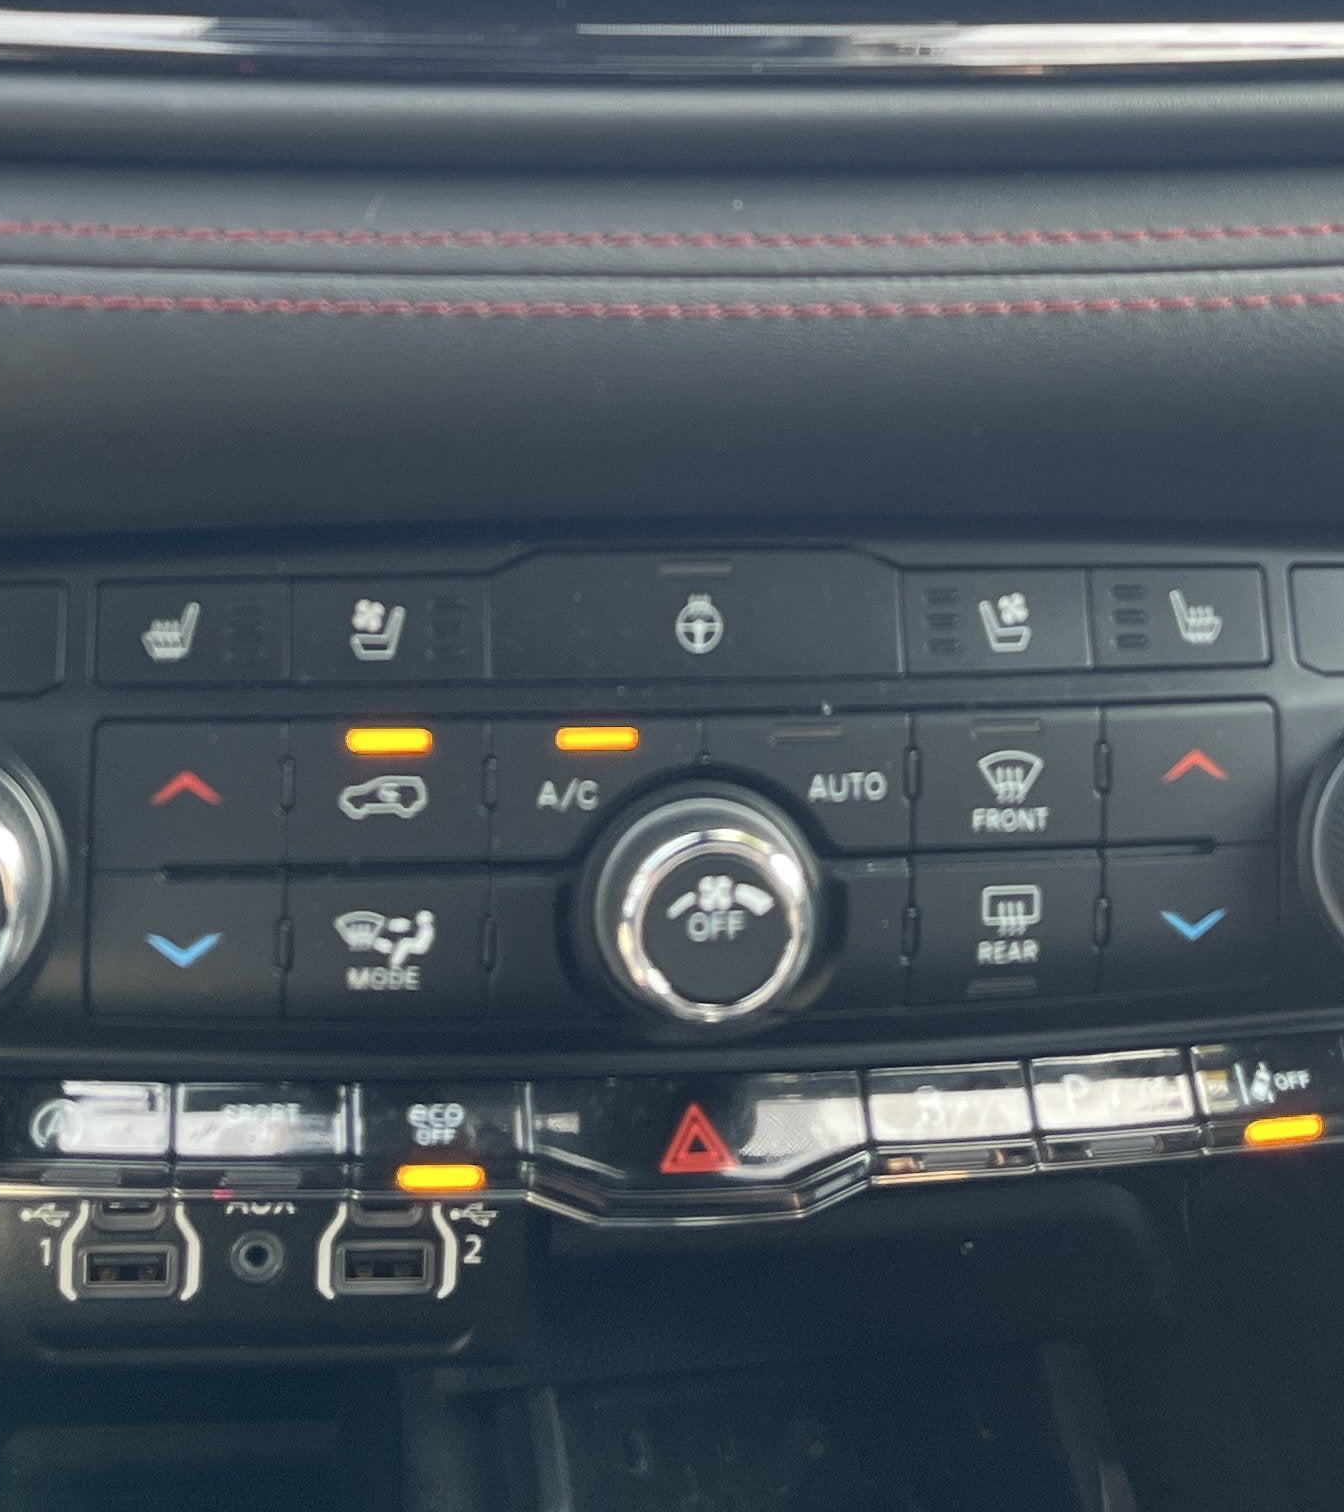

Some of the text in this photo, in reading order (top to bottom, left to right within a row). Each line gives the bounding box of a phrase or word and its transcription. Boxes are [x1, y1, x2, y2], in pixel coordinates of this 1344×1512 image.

[537, 780, 600, 812] A/C
[808, 771, 887, 804] AUTO
[971, 807, 1049, 835] FRONT
[686, 910, 746, 945] OFF
[976, 938, 1039, 966] REAR
[346, 966, 422, 992] MODE
[1273, 1068, 1312, 1092] OFF
[414, 1126, 458, 1146] OFF
[464, 1236, 483, 1264] 2
